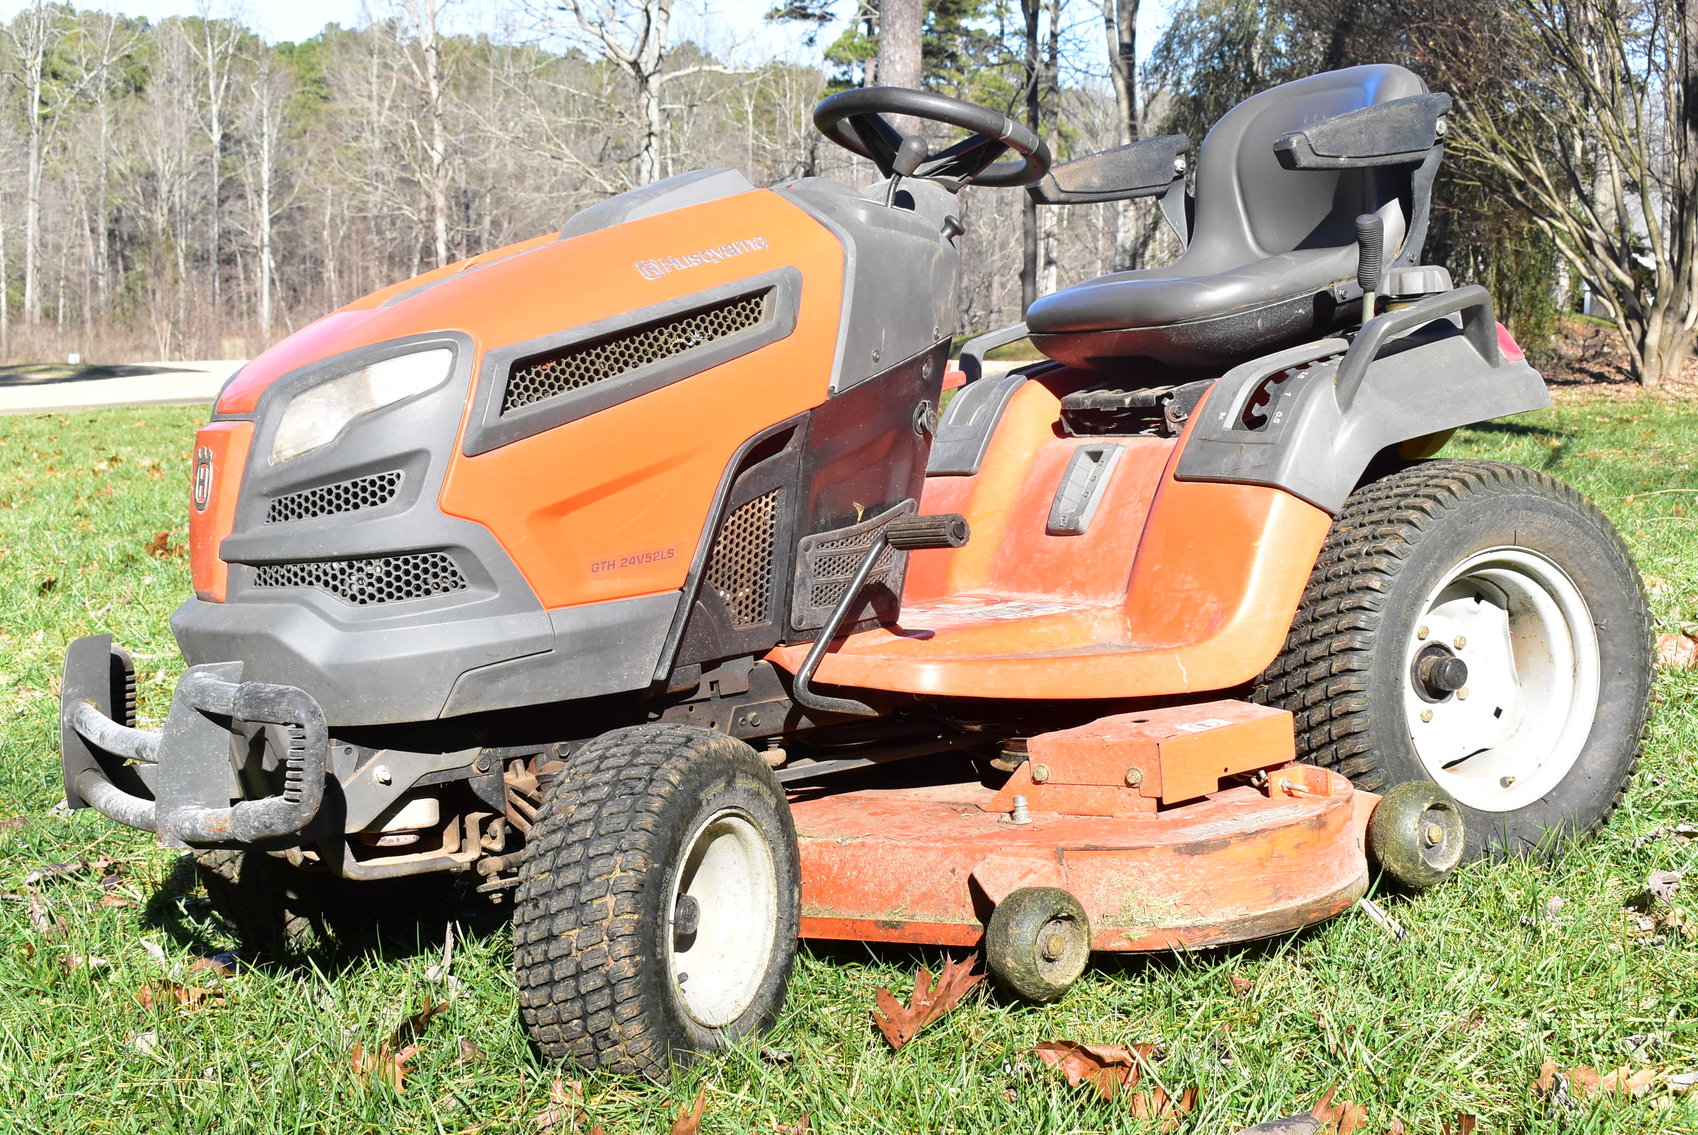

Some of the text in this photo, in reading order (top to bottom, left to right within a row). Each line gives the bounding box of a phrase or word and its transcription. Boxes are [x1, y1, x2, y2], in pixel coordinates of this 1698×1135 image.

[659, 236, 769, 273] Husqvarna
[1272, 411, 1283, 424] 0.5
[591, 548, 675, 573] GTH 24V52LS
